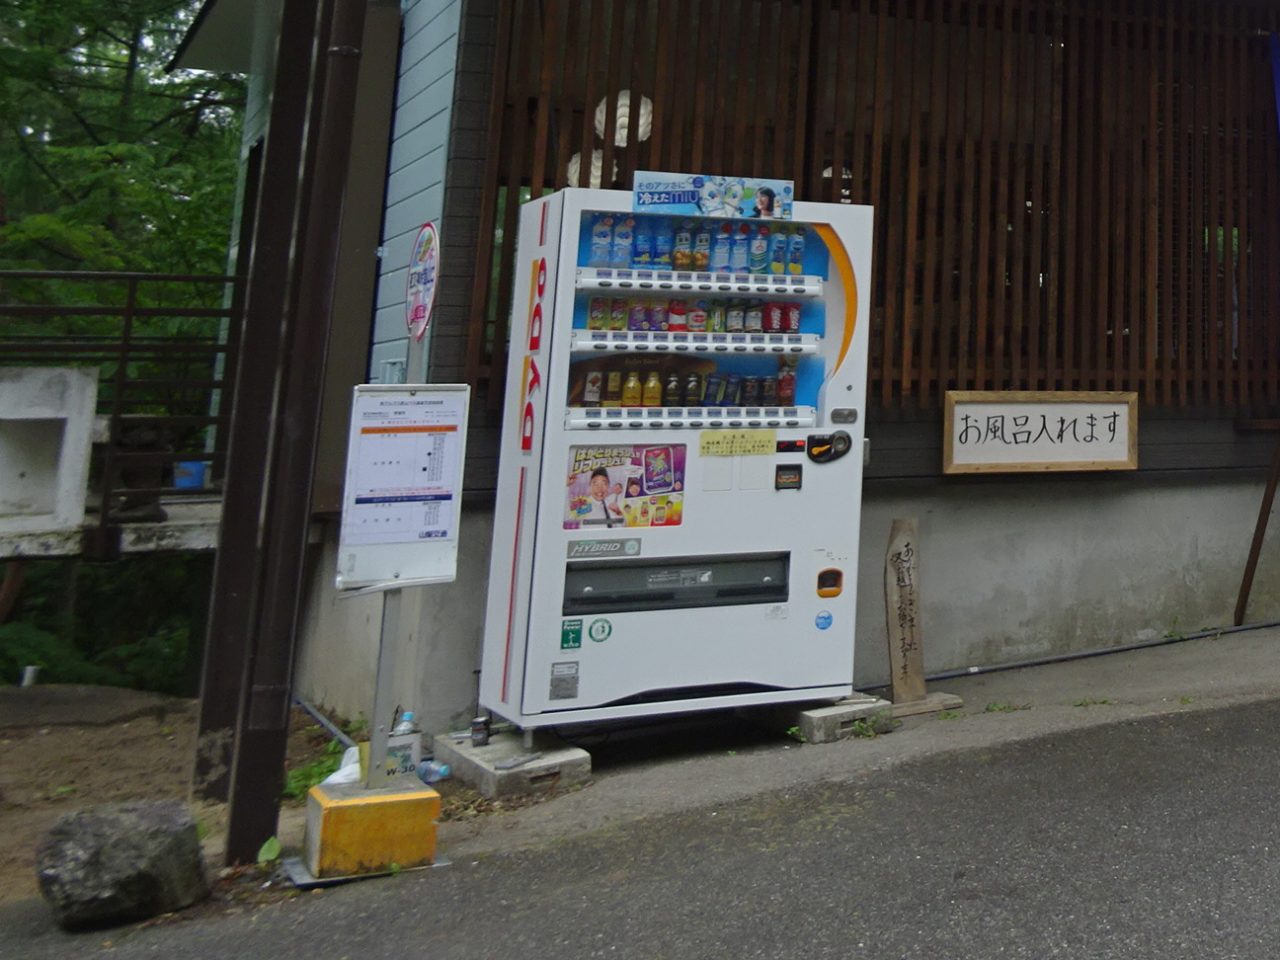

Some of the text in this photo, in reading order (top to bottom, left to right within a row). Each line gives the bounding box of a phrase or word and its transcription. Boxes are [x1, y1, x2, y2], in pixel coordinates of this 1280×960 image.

[958, 411, 1120, 445] お風呂入れます
